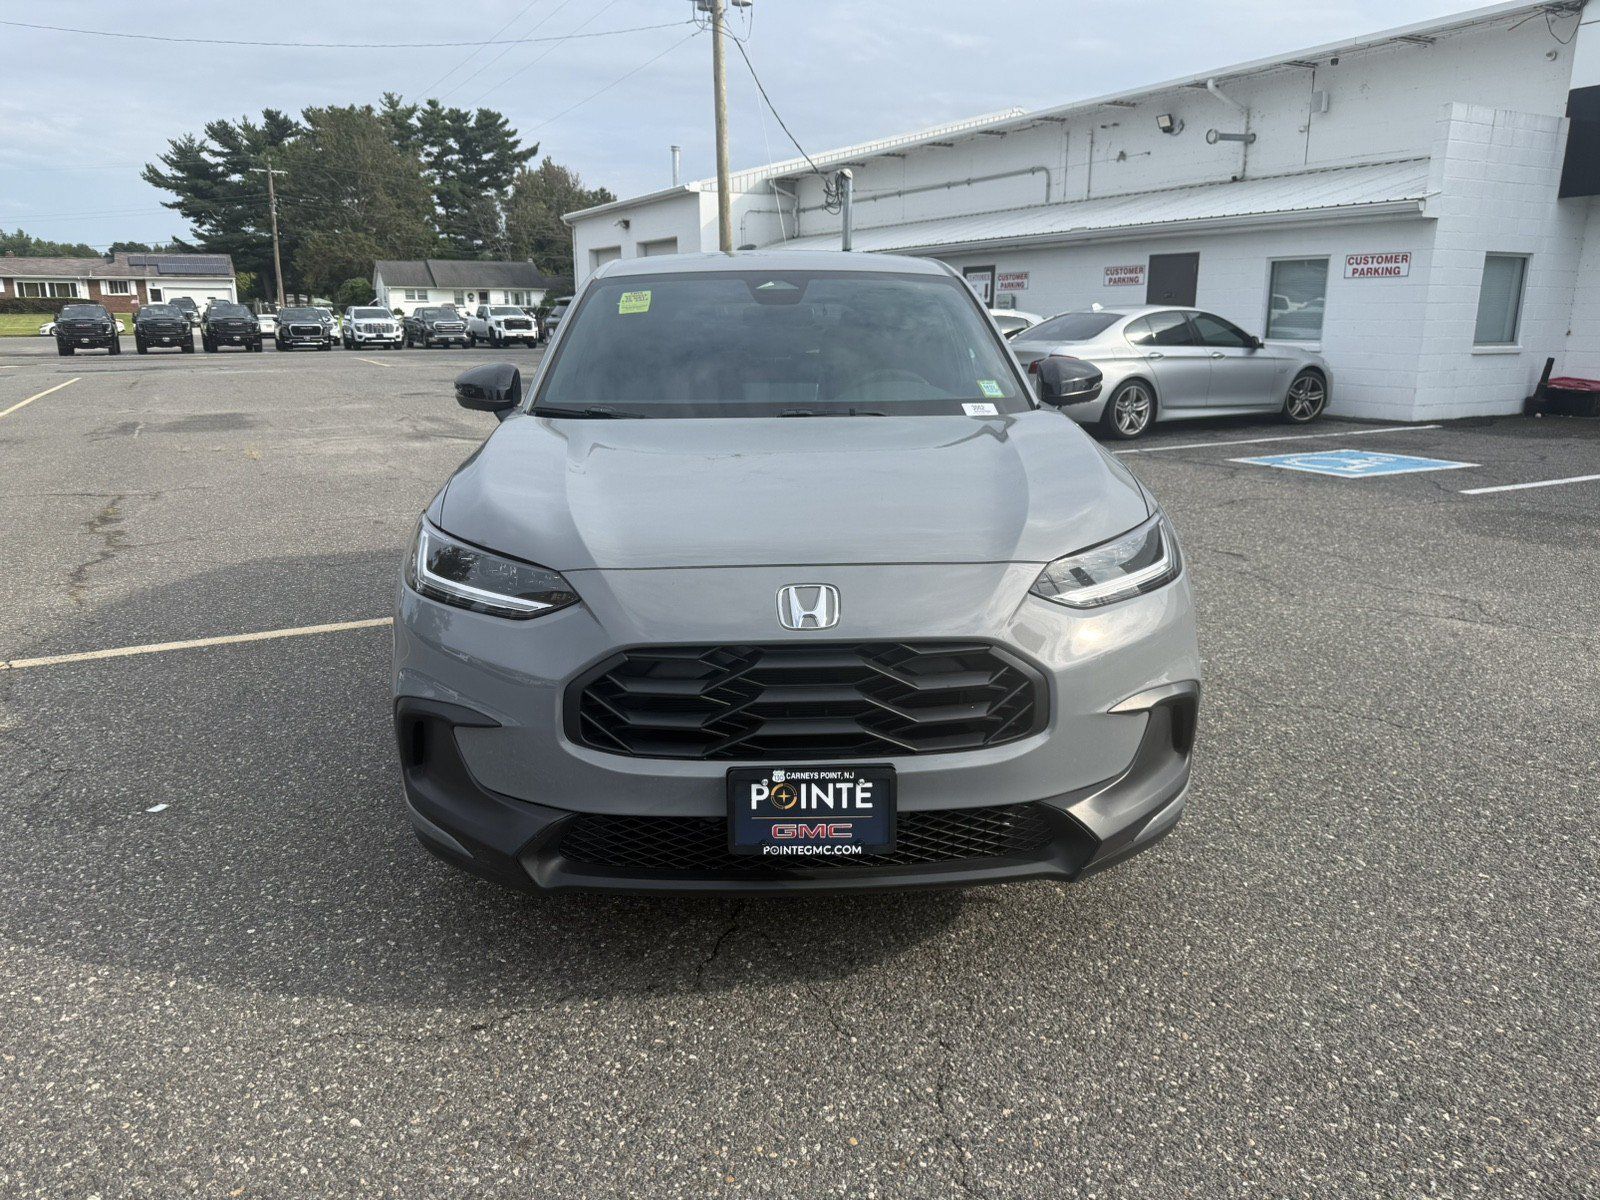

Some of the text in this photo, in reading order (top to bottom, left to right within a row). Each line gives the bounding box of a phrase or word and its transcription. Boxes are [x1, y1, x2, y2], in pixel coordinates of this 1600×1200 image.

[1347, 254, 1409, 266] CUSTOMER
[1105, 266, 1144, 276] CUSTOMER
[1351, 266, 1401, 277] PARKING
[997, 272, 1029, 281] CUSTOMER
[1108, 276, 1140, 285] PARKING
[1000, 281, 1025, 289] PARKING
[786, 771, 855, 780] CARNEYS POINT, NJ
[750, 781, 874, 810] POINTE
[771, 823, 853, 839] GMC
[763, 844, 862, 856] POINTEGMC.COM
